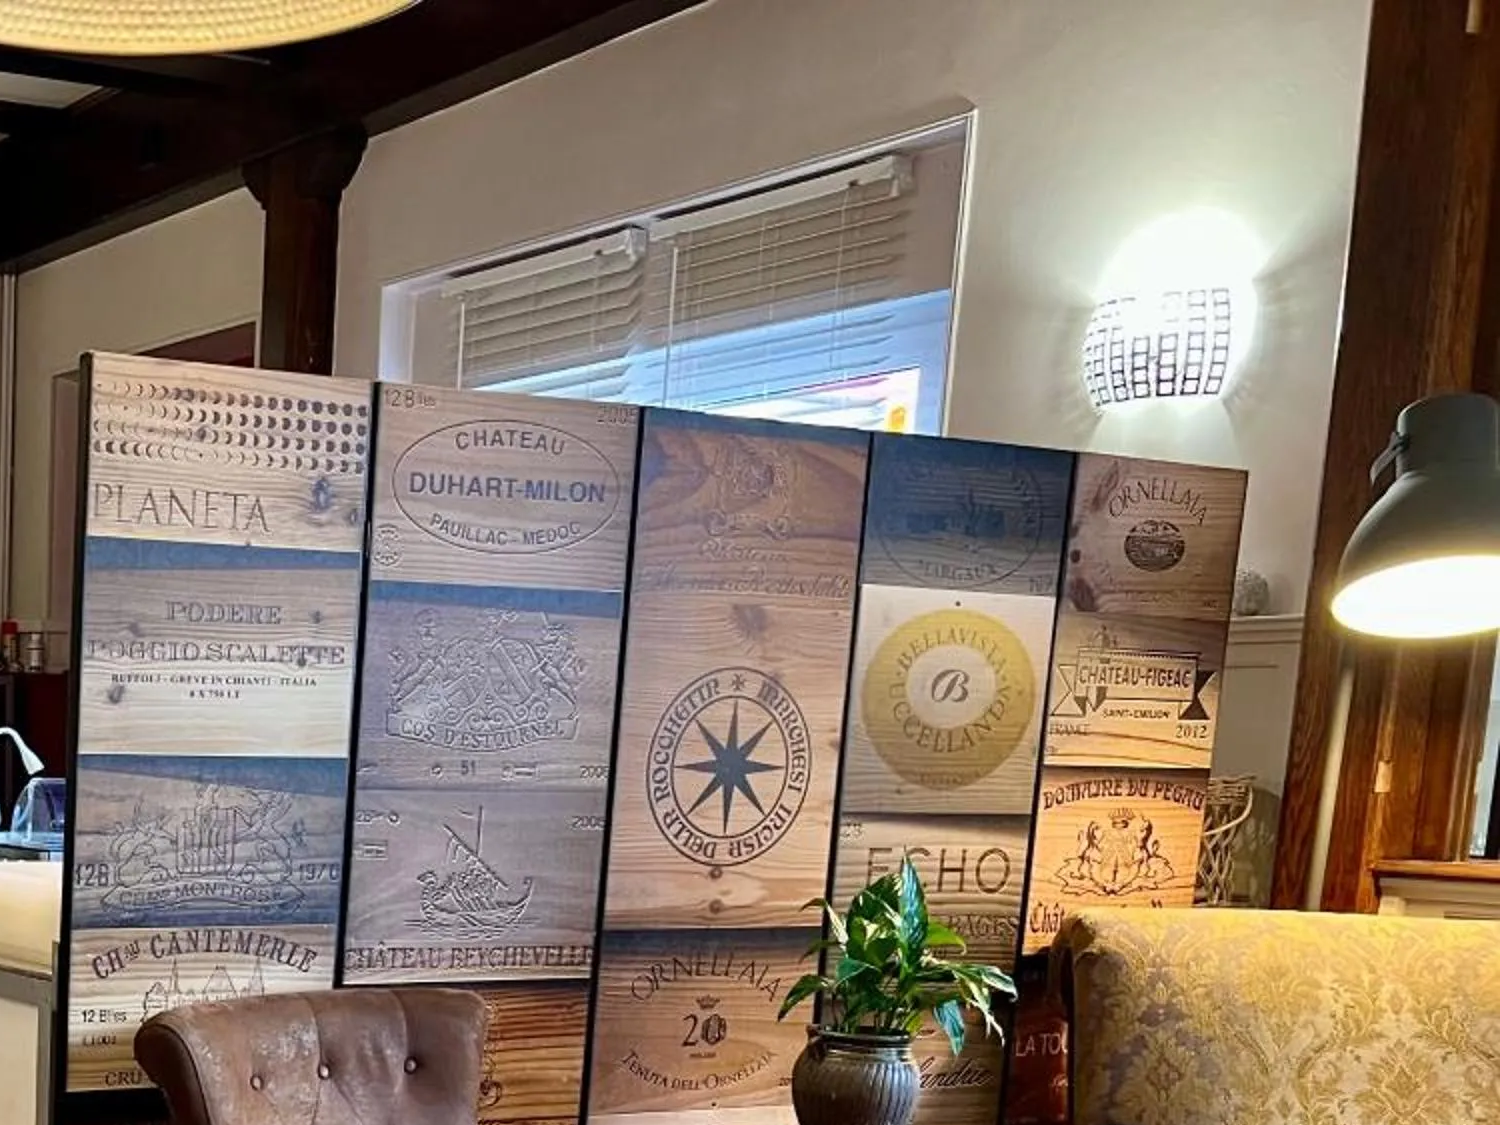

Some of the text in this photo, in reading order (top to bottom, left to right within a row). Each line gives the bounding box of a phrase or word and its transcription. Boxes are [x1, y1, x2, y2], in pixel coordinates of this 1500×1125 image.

[455, 429, 565, 455] CHATEAU
[409, 472, 606, 503] DUHART-MILON
[93, 483, 272, 533] PLANETA
[1109, 477, 1208, 527] ORNELLAIA
[165, 600, 284, 625] PODERE
[87, 638, 346, 665] POGGIO SCALETTE
[931, 669, 972, 703] B
[1078, 665, 1192, 689] CHATEAU-FIGEAC
[1175, 724, 1210, 739] 2012
[1128, 777, 1150, 799] DU
[174, 882, 282, 904] MONTROSE
[149, 927, 318, 974] CANTEMERLE
[631, 951, 781, 1003] ORNELLAIA
[1014, 1034, 1035, 1057] LA
[104, 1070, 142, 1087] CRU
